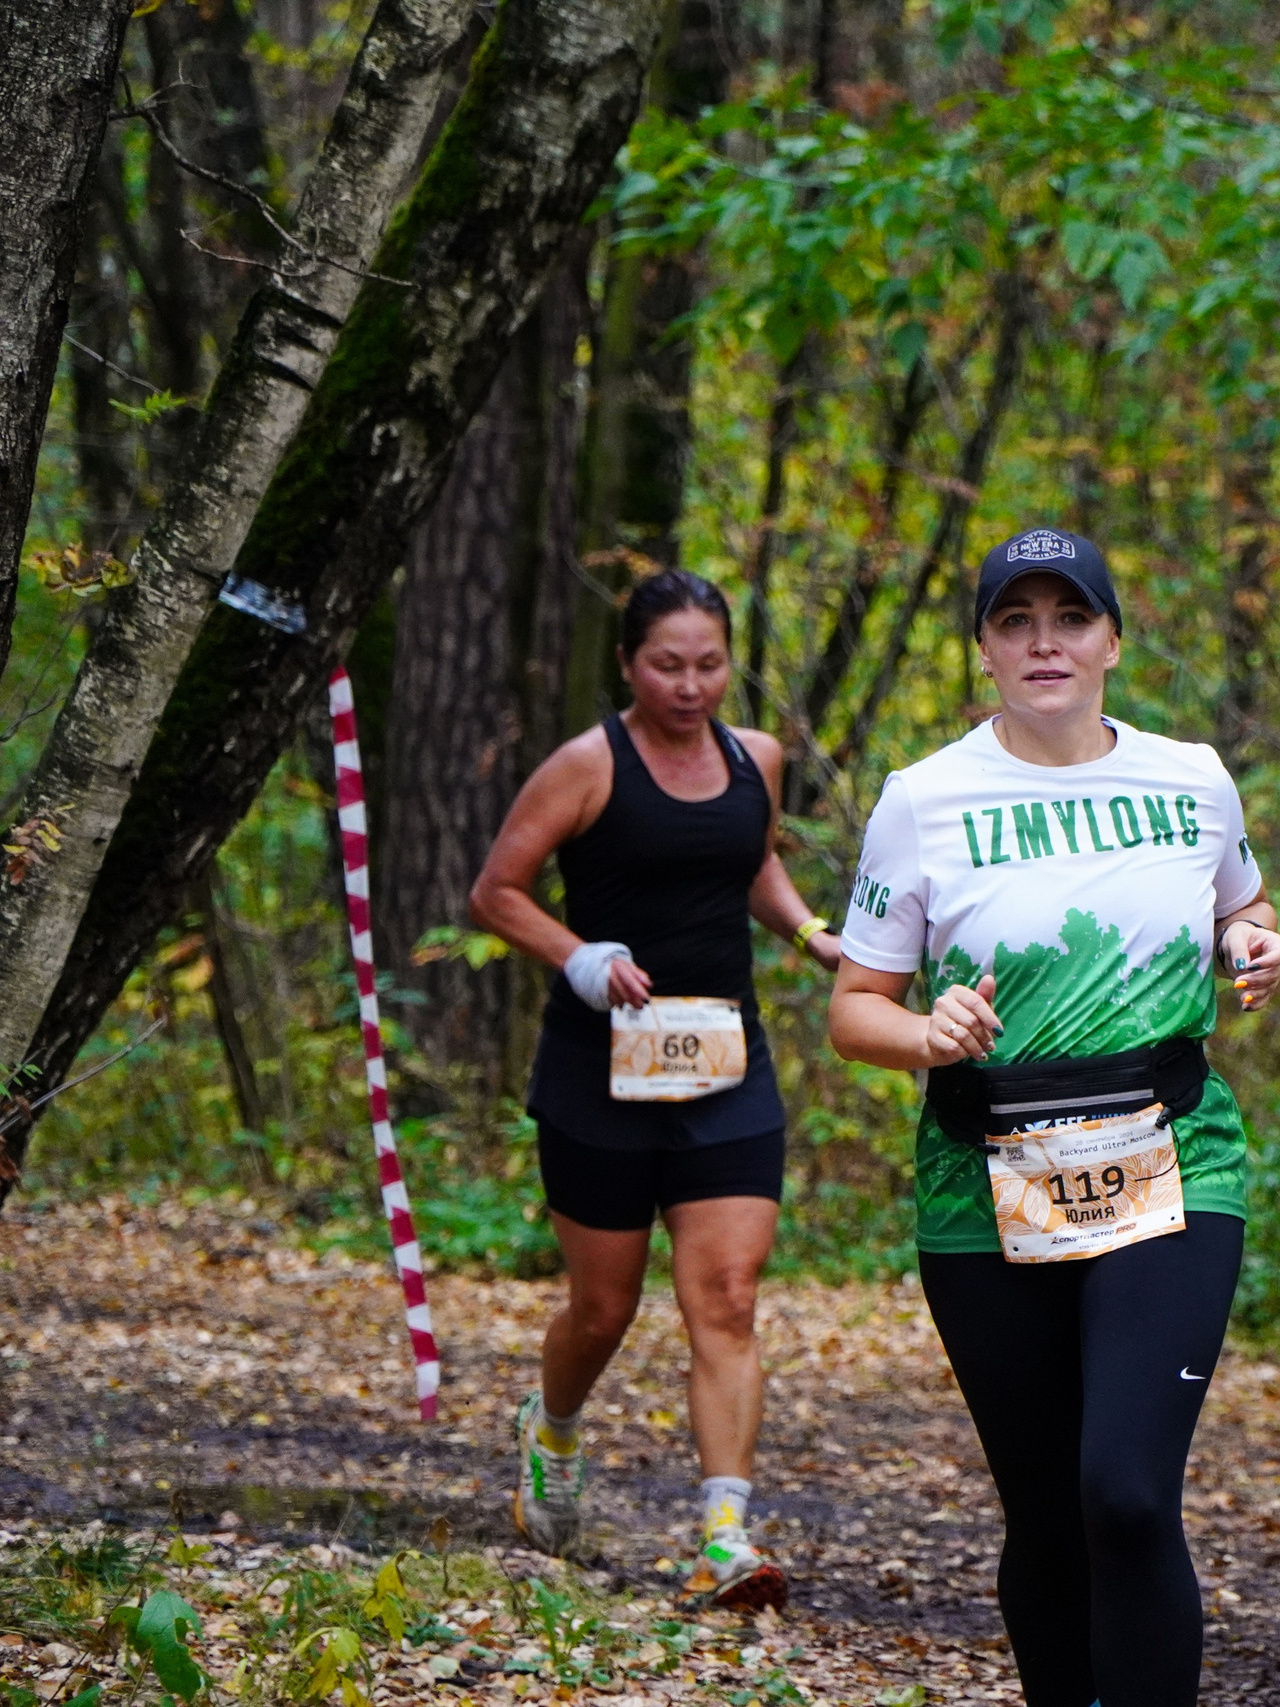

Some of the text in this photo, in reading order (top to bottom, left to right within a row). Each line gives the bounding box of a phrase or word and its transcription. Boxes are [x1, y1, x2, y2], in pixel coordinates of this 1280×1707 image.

[1020, 541, 1060, 551] NEW ERA
[962, 794, 1200, 868] IZMYLONG
[664, 1034, 699, 1058] 60
[1060, 1130, 1157, 1158] Backyard Ultra Moscow
[1047, 1165, 1125, 1205] 119
[1065, 1206, 1115, 1223] Юлия
[1116, 1223, 1137, 1234] PRO
